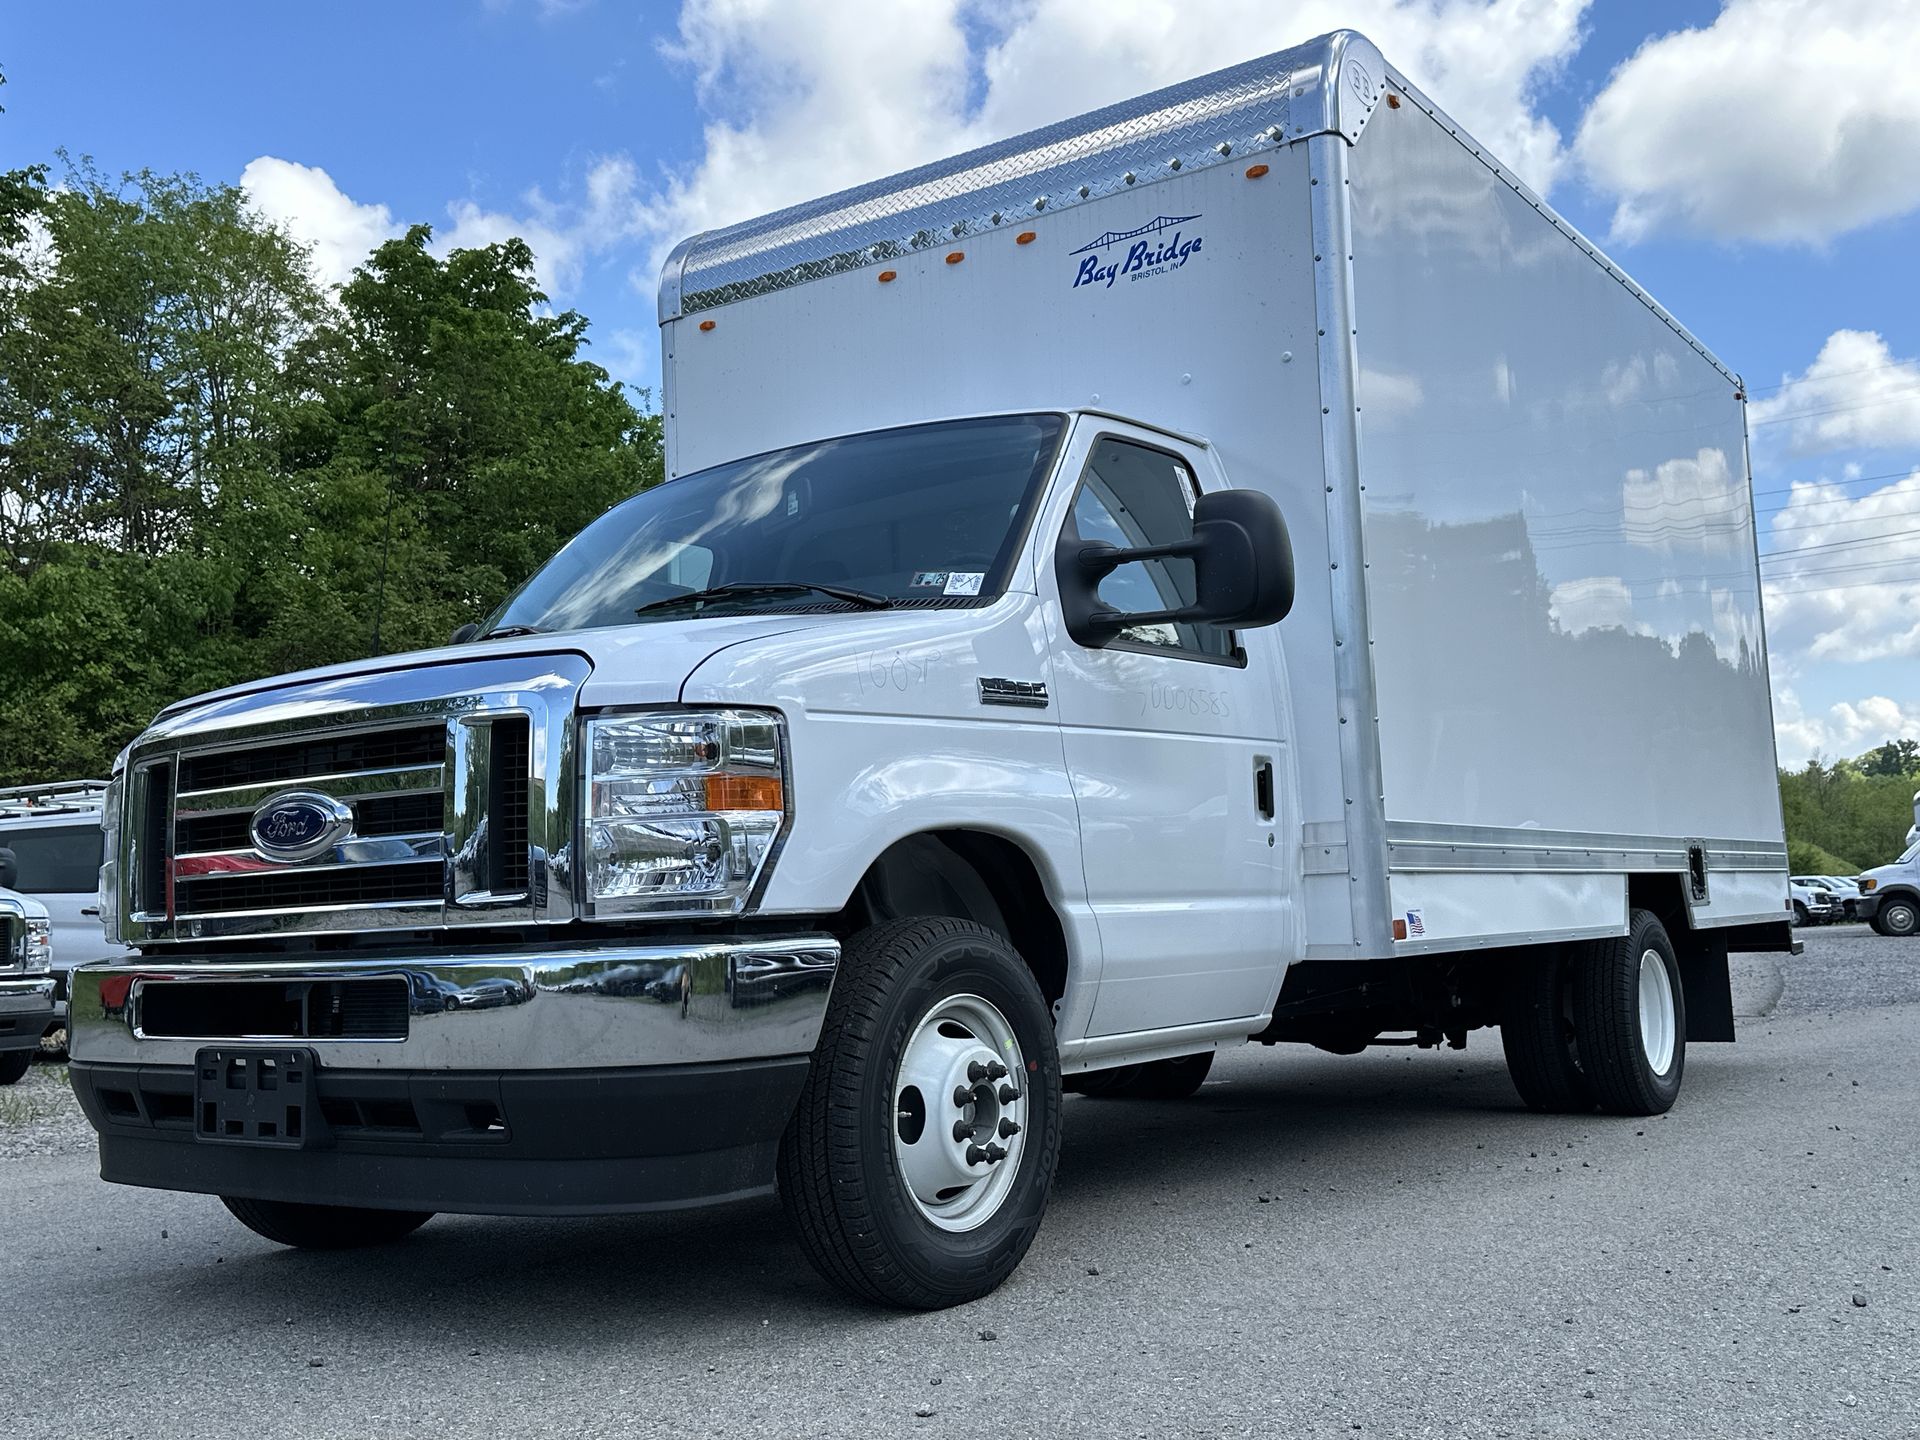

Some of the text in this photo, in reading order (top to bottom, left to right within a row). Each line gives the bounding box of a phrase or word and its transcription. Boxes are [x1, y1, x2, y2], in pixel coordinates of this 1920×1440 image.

[1073, 231, 1203, 289] Bay Bridge
[1131, 262, 1180, 282] BRISTOL, IN
[266, 810, 310, 839] Ford
